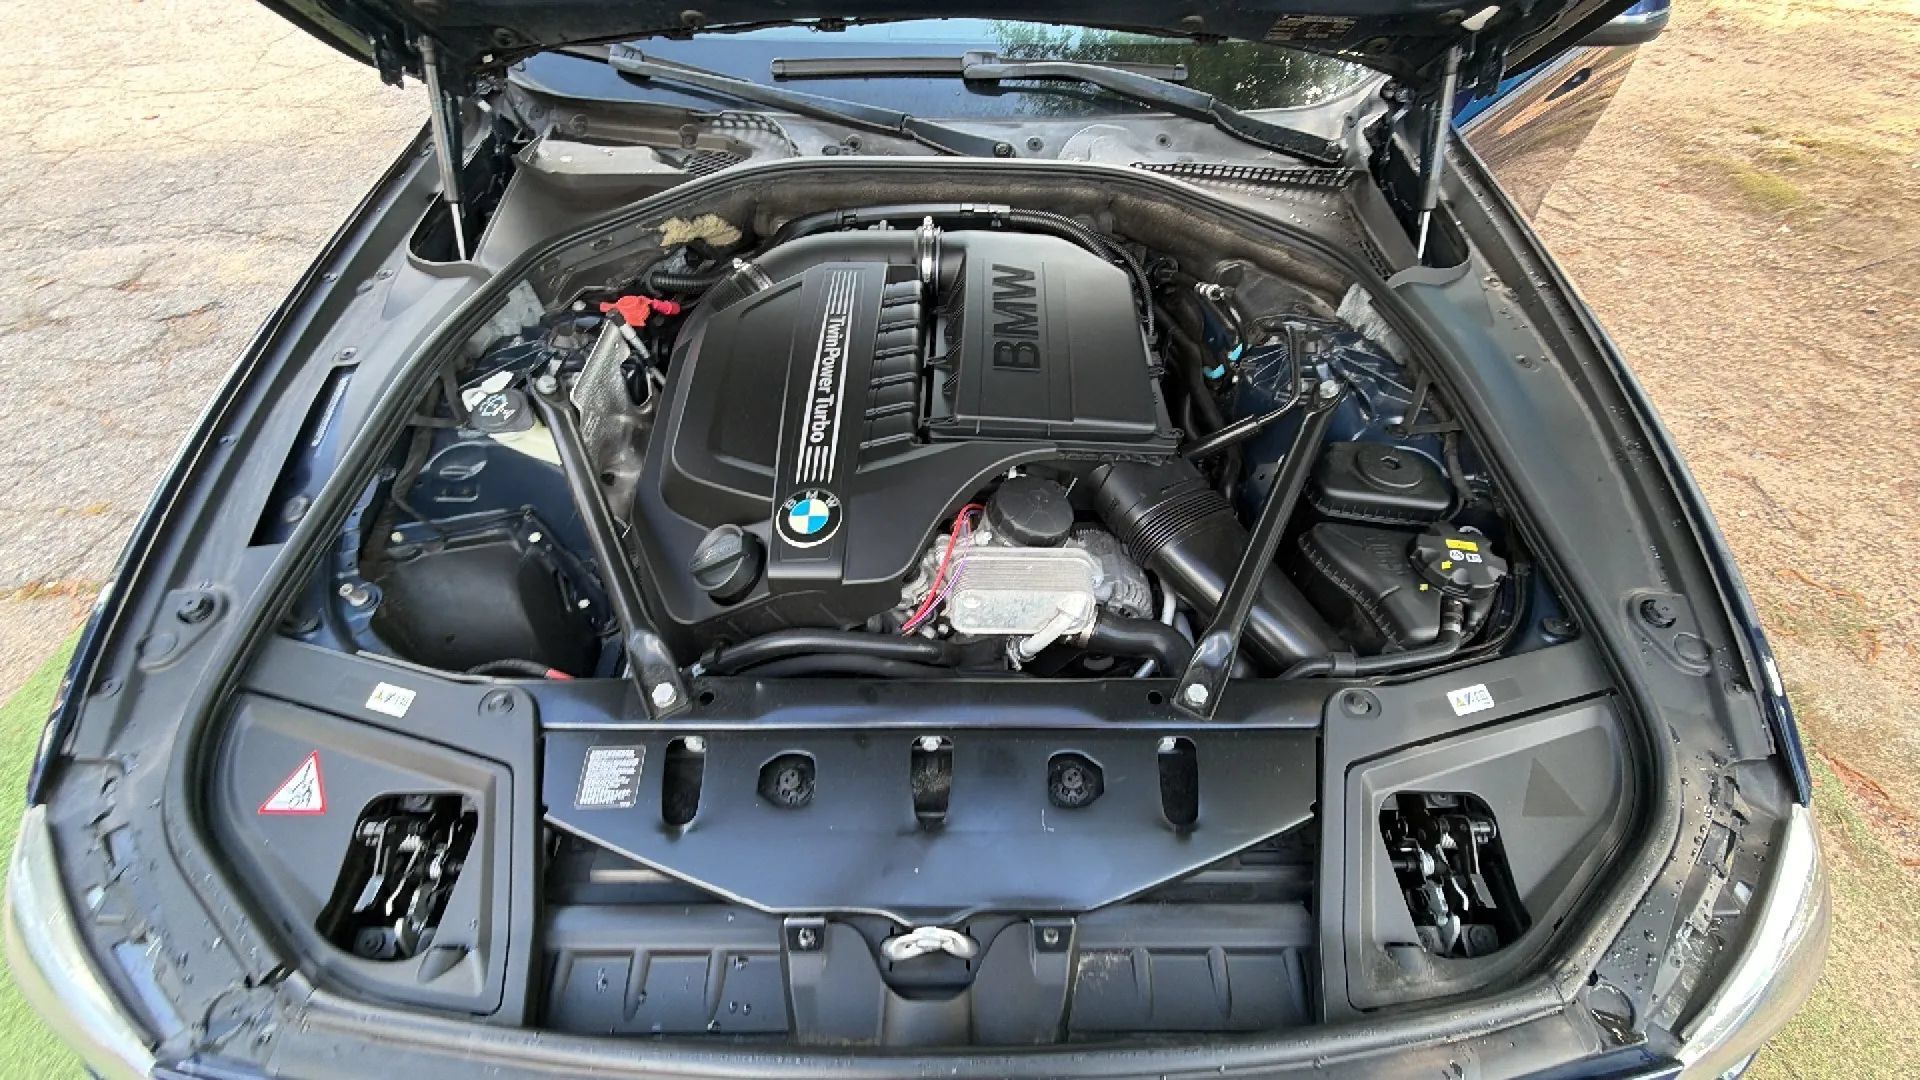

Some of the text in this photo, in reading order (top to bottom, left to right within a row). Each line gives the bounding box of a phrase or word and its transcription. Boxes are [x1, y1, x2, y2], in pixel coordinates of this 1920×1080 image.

[991, 263, 1040, 372] BMW
[809, 315, 847, 443] TwinPower Turbo
